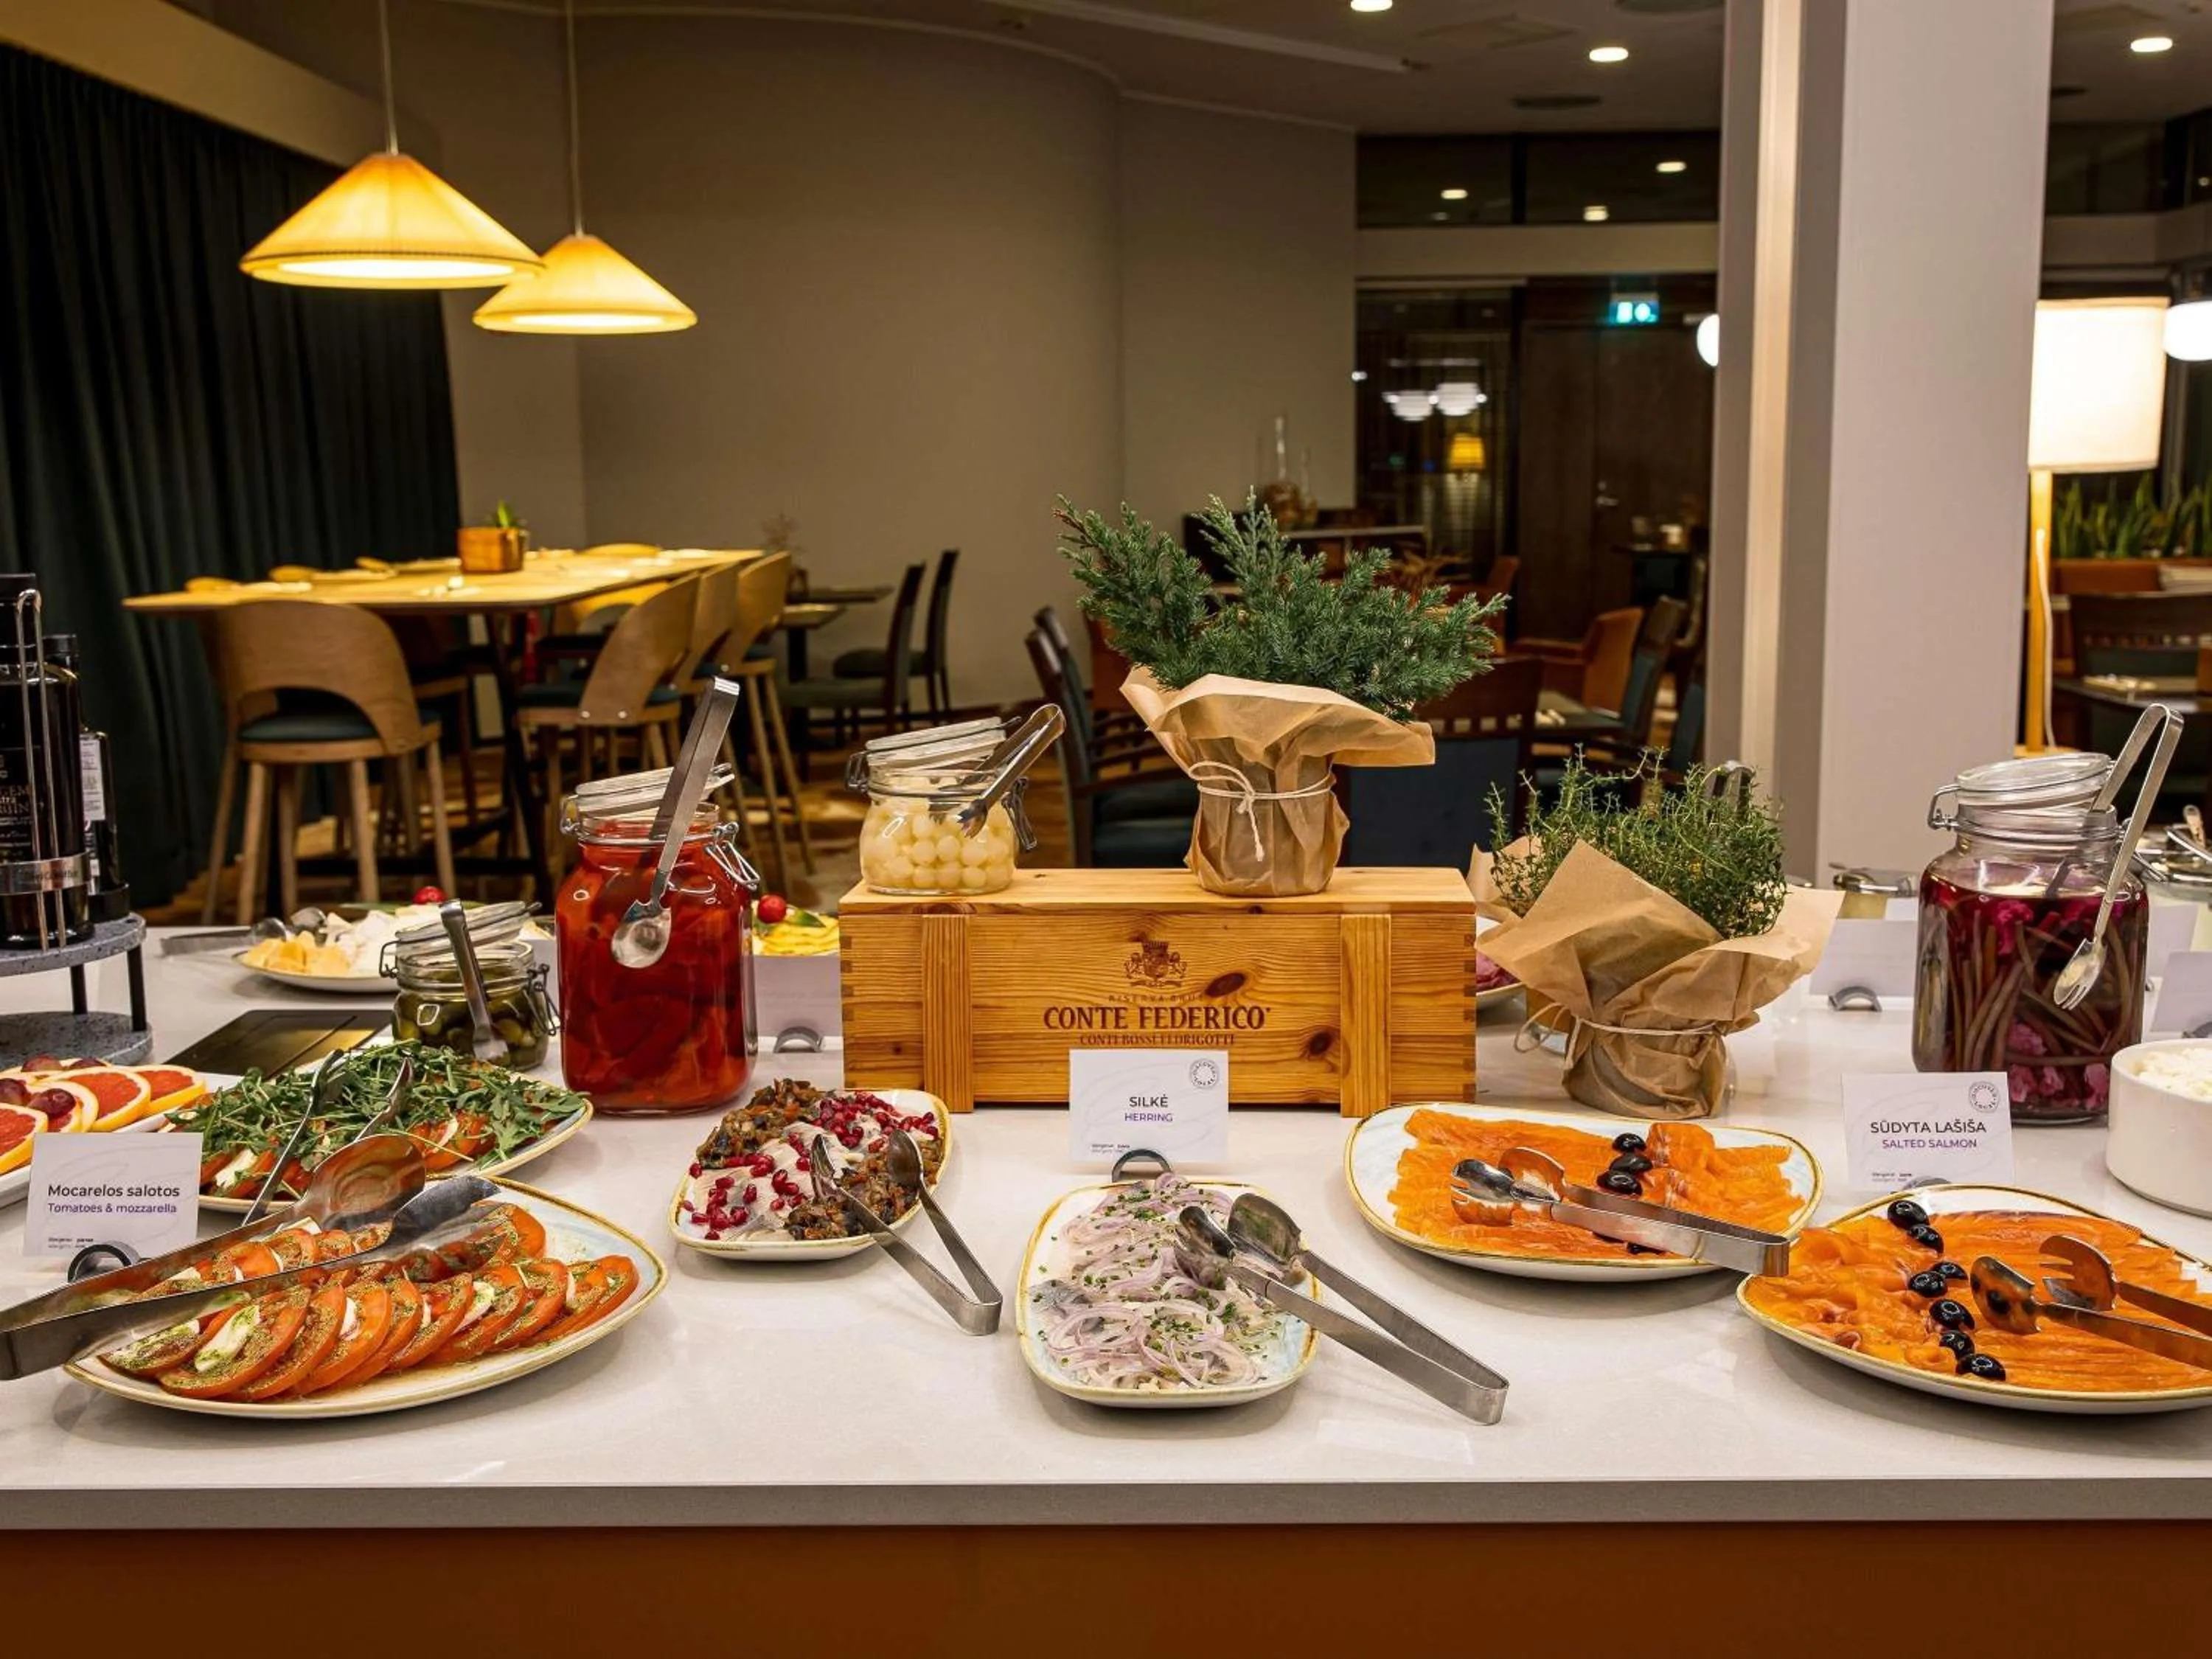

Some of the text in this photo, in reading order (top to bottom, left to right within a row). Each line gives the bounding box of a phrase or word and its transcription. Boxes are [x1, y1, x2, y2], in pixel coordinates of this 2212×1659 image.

[1043, 1006, 1265, 1029] CONTE FEDERICO
[1129, 1093, 1169, 1107] SILKĖ
[1124, 1113, 1173, 1122] HERRING
[1935, 1119, 1986, 1133] LAŠIŠA
[1882, 1138, 1978, 1149] SALTED SALMON
[48, 1184, 181, 1197] Mocarelos salotos
[48, 1203, 178, 1213] Tomatoes & mozzarella
